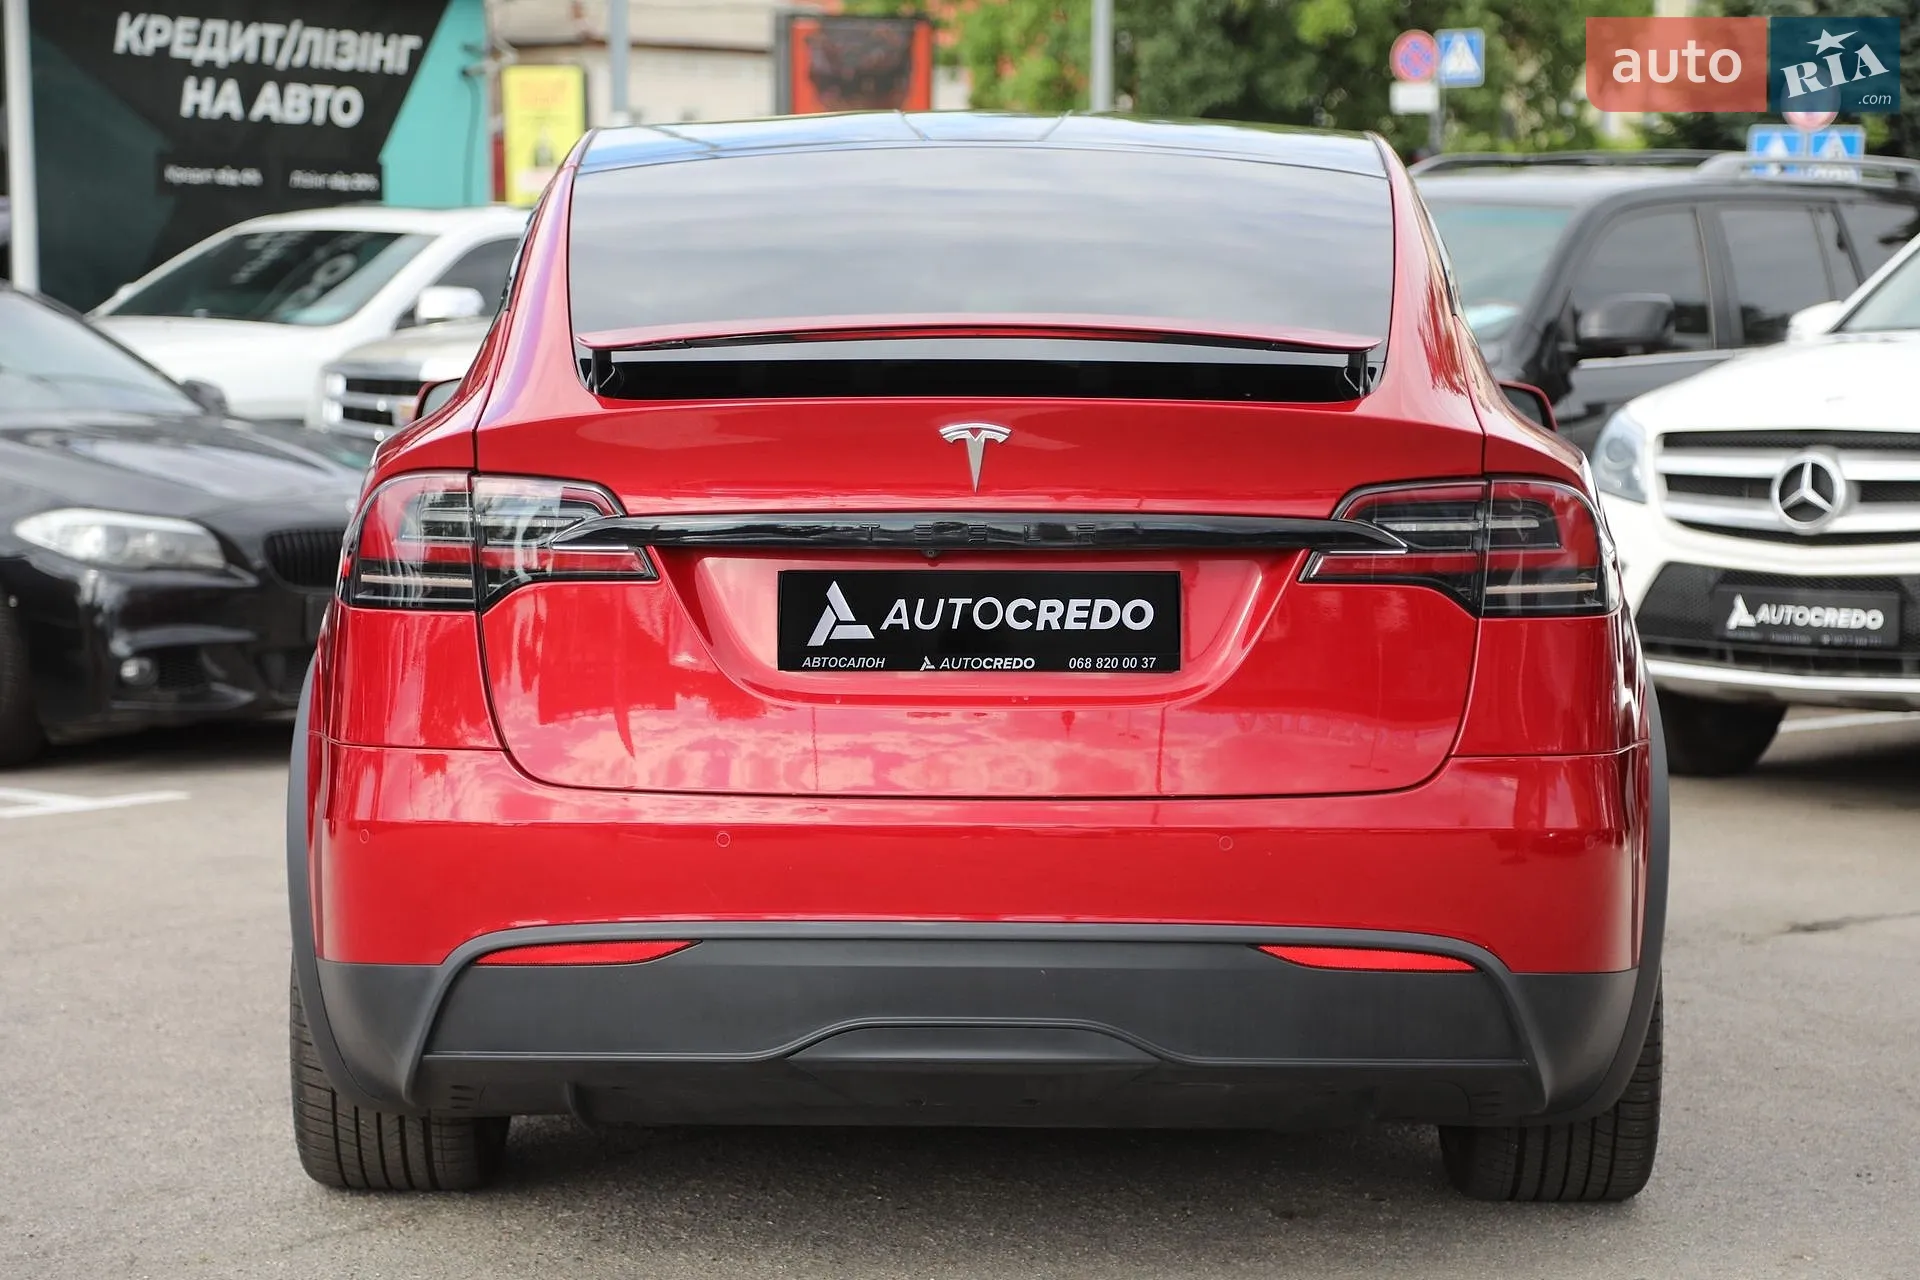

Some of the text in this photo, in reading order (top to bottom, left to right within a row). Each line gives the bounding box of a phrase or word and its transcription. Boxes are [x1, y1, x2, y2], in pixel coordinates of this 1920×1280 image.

[113, 11, 423, 75] КРЕДИТ/ЛІЗІНГ
[179, 75, 365, 129] НА АВТО
[879, 596, 1155, 631] AUTOCREDO
[1754, 603, 1884, 630] AUTOCREDO
[802, 656, 886, 669] АВТОСАЛОН
[939, 657, 1036, 669] AUTOCREDO
[1069, 657, 1156, 669] 068 820 00 37
